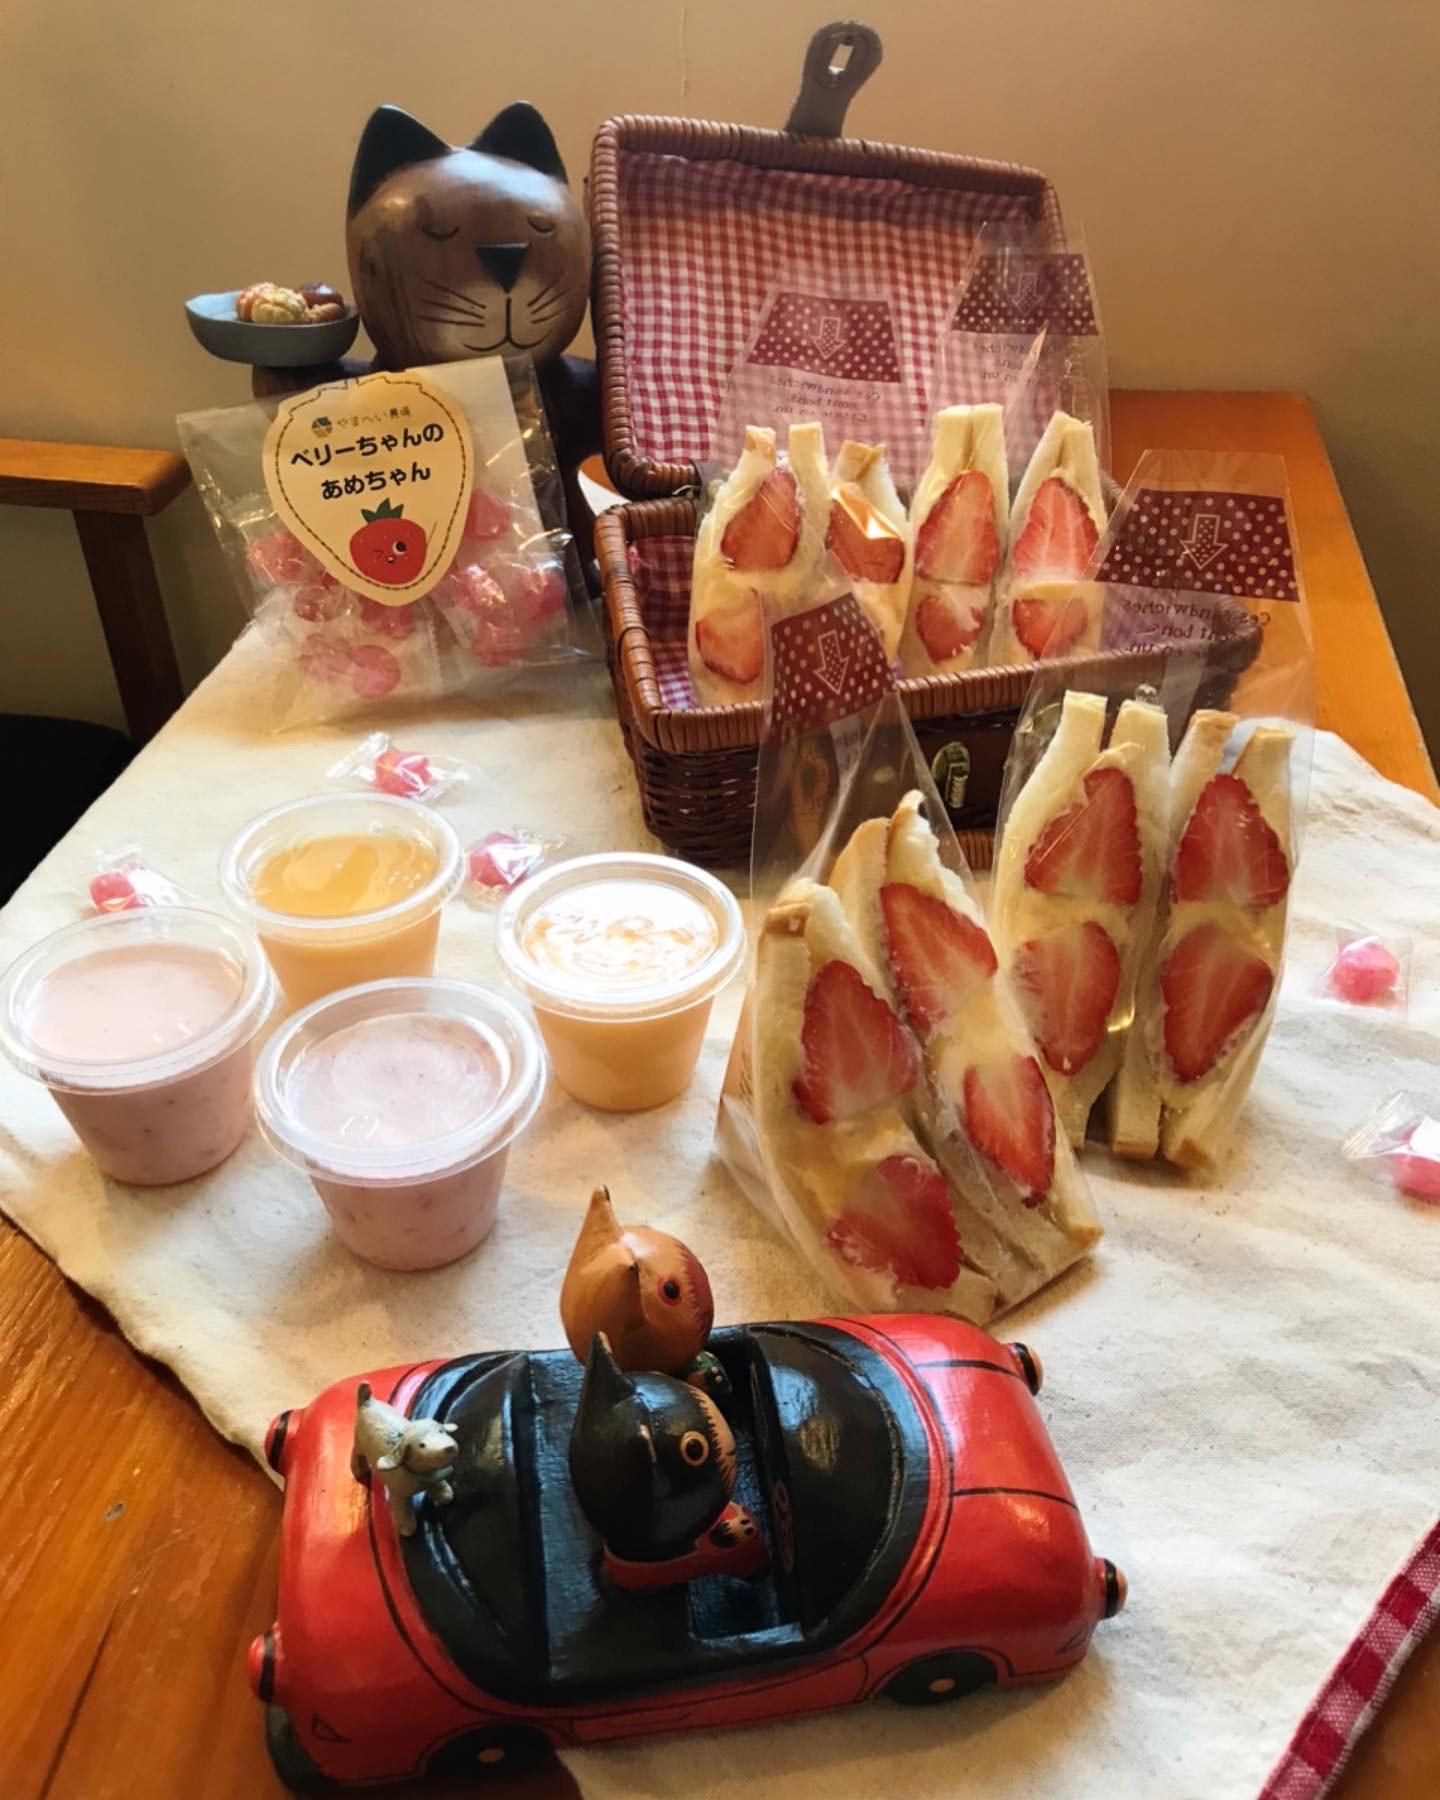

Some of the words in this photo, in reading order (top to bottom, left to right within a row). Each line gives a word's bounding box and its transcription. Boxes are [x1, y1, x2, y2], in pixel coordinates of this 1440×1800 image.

[290, 423, 444, 466] ベリーちゃんの
[321, 462, 431, 500] あめちゃん
